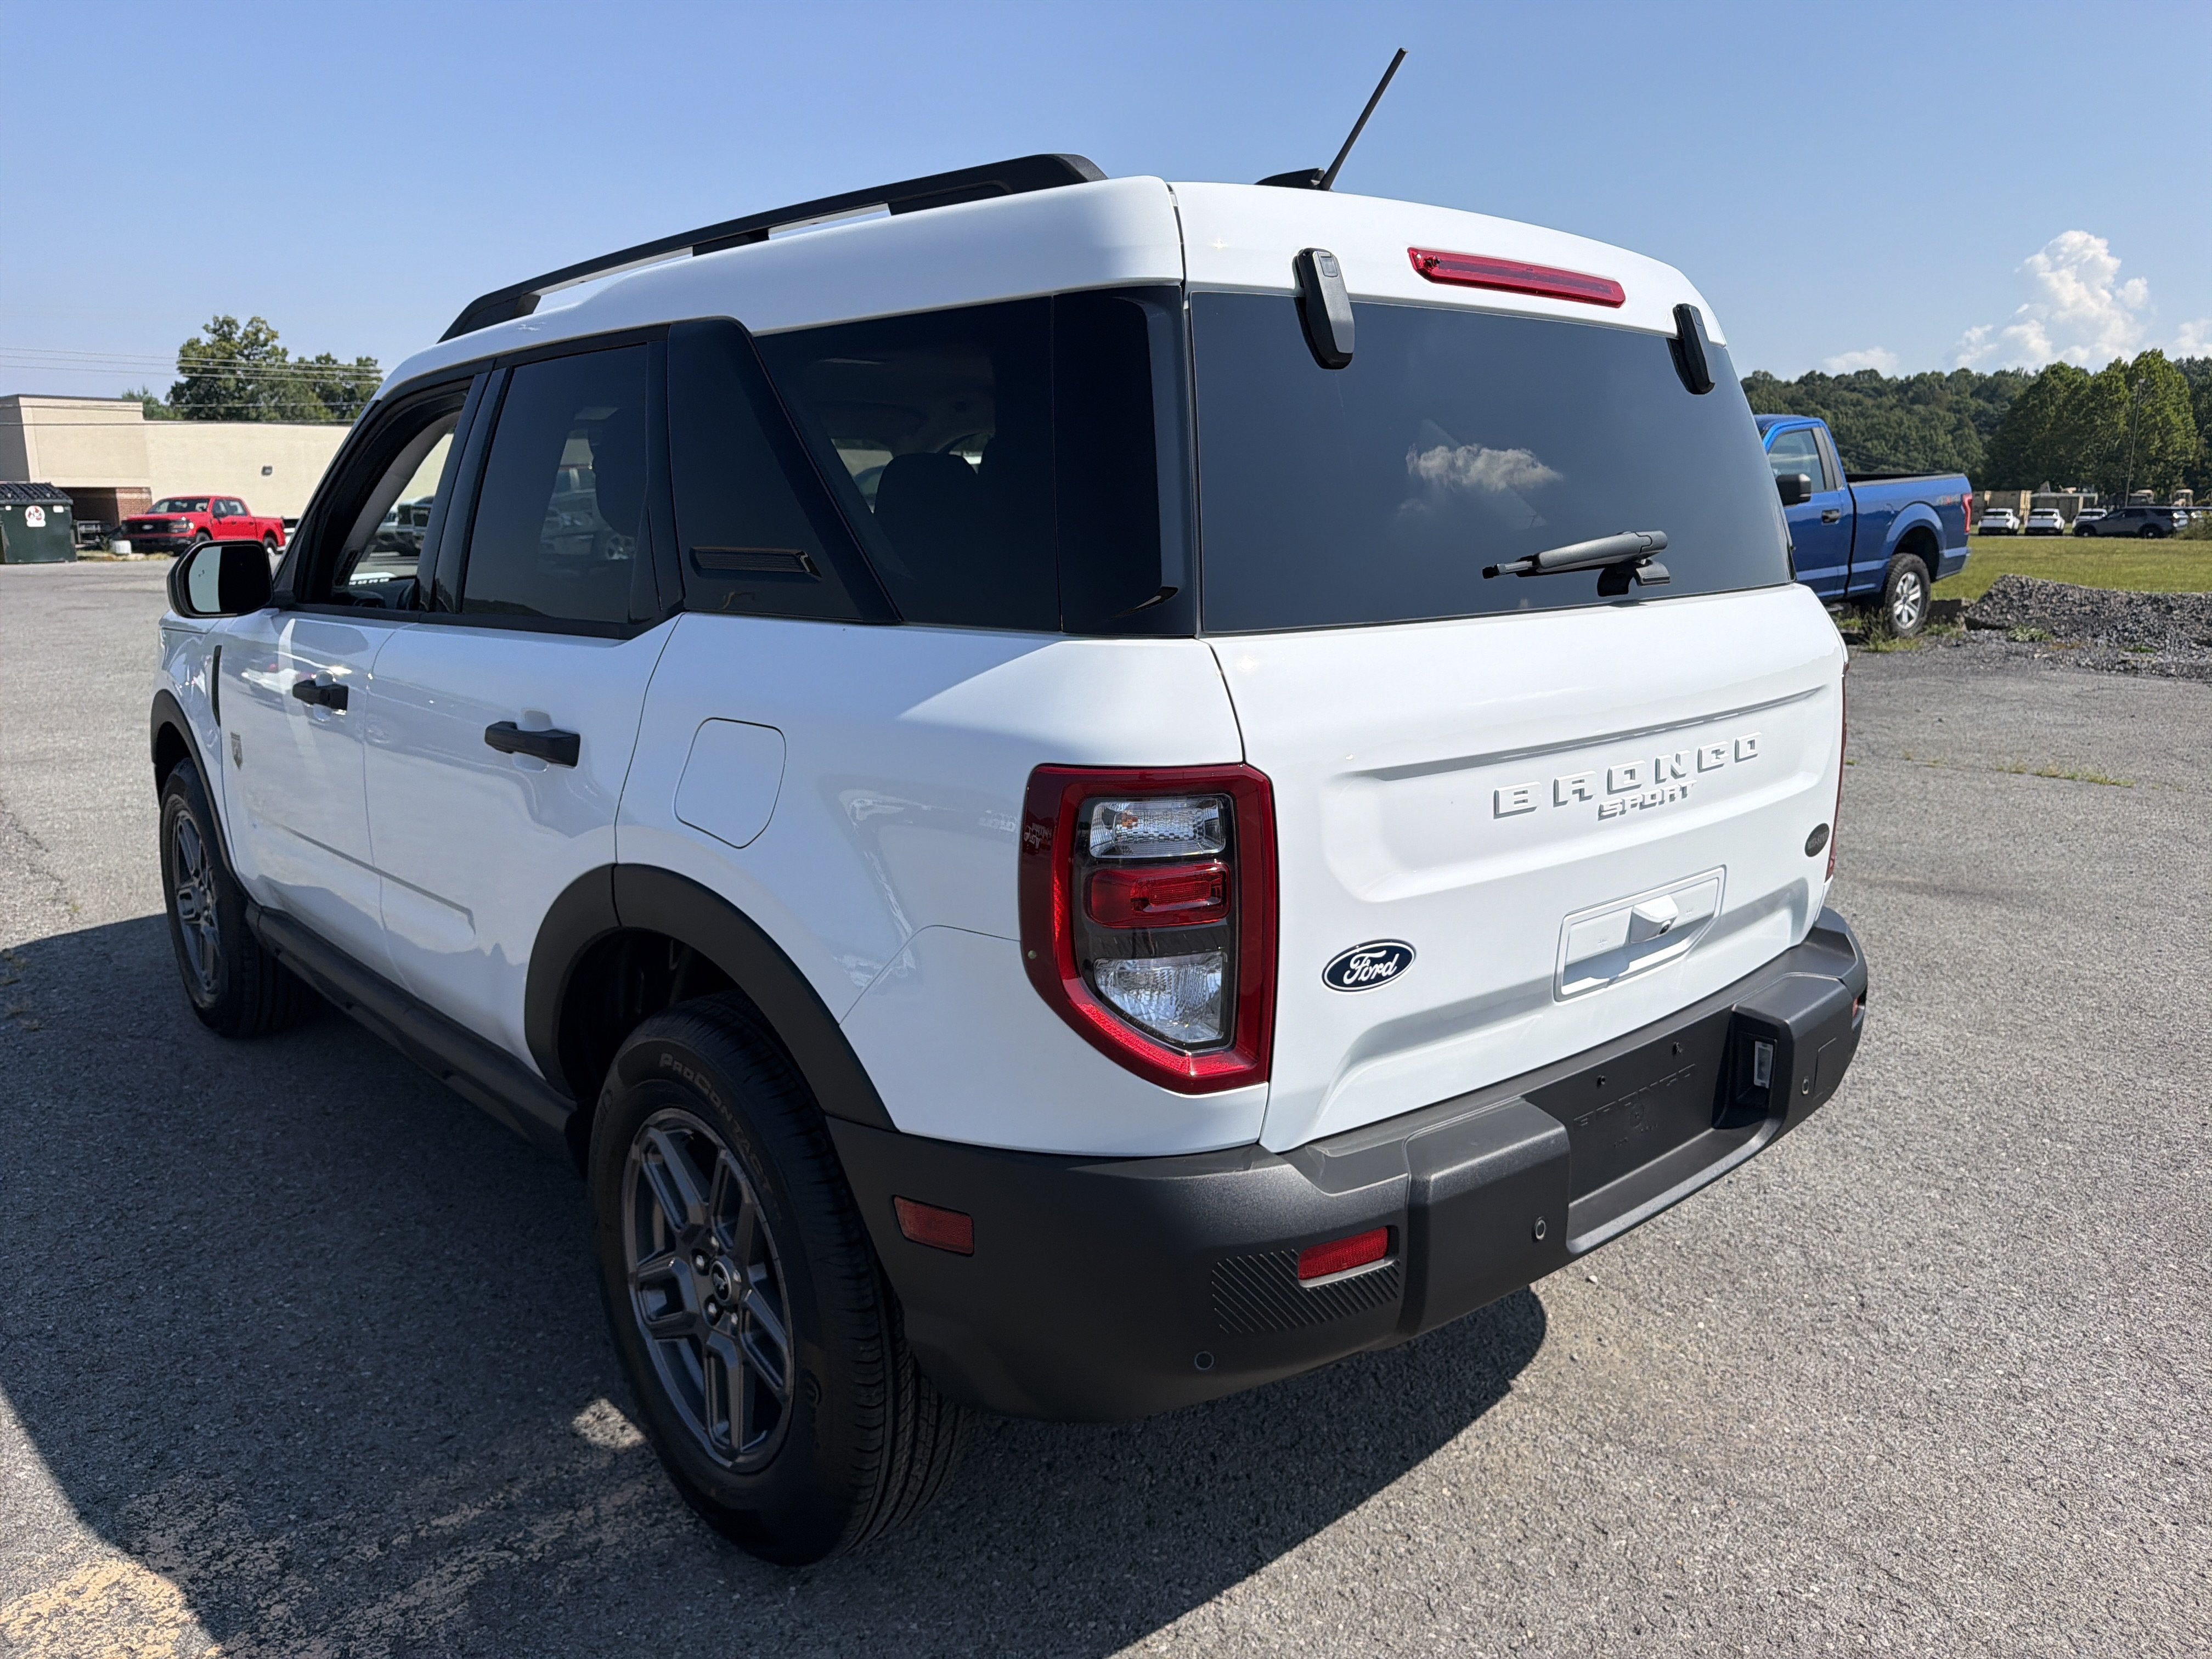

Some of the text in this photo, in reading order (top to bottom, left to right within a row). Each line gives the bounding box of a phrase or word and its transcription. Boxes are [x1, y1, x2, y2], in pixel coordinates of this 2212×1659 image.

[1494, 731, 1762, 818] BRONCO
[1599, 780, 1697, 820] SPORT
[1343, 950, 1400, 984] Ford
